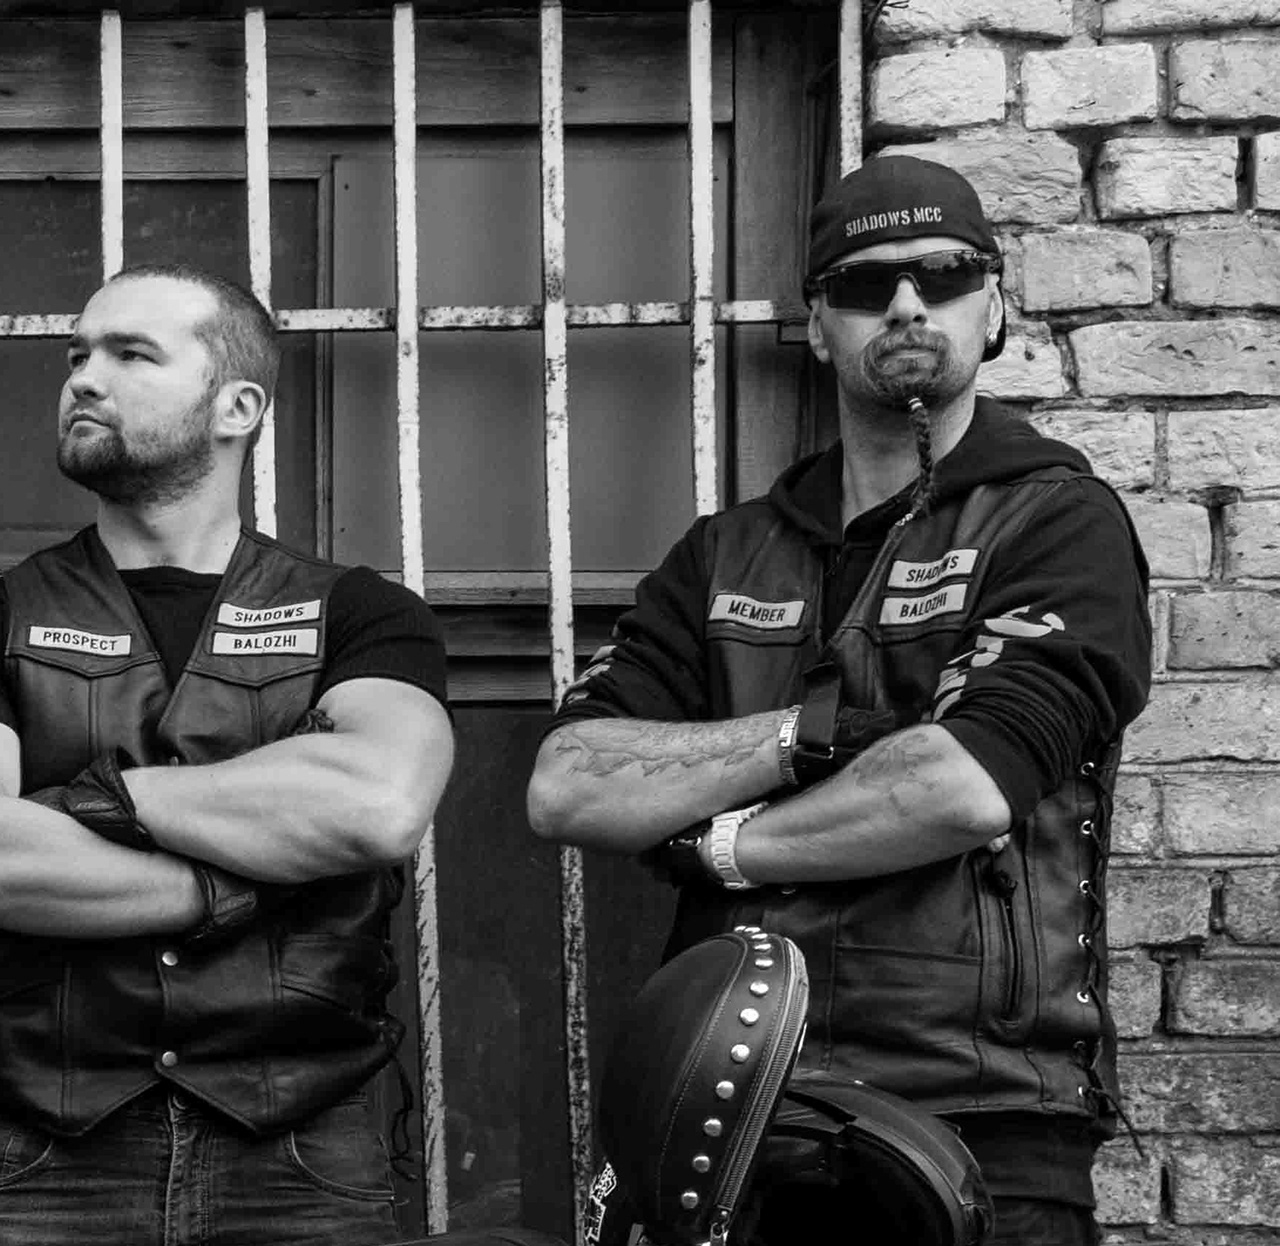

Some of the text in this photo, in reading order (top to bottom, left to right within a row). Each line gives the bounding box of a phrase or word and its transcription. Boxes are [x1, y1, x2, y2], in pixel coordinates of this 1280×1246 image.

[846, 206, 943, 238] SHADOWS MCC
[234, 606, 304, 623] SHADOWS
[727, 599, 786, 622] MEMBER
[899, 591, 948, 618] BALOZHI
[43, 631, 118, 651] PROSPECT
[233, 634, 297, 649] BALOZHI
